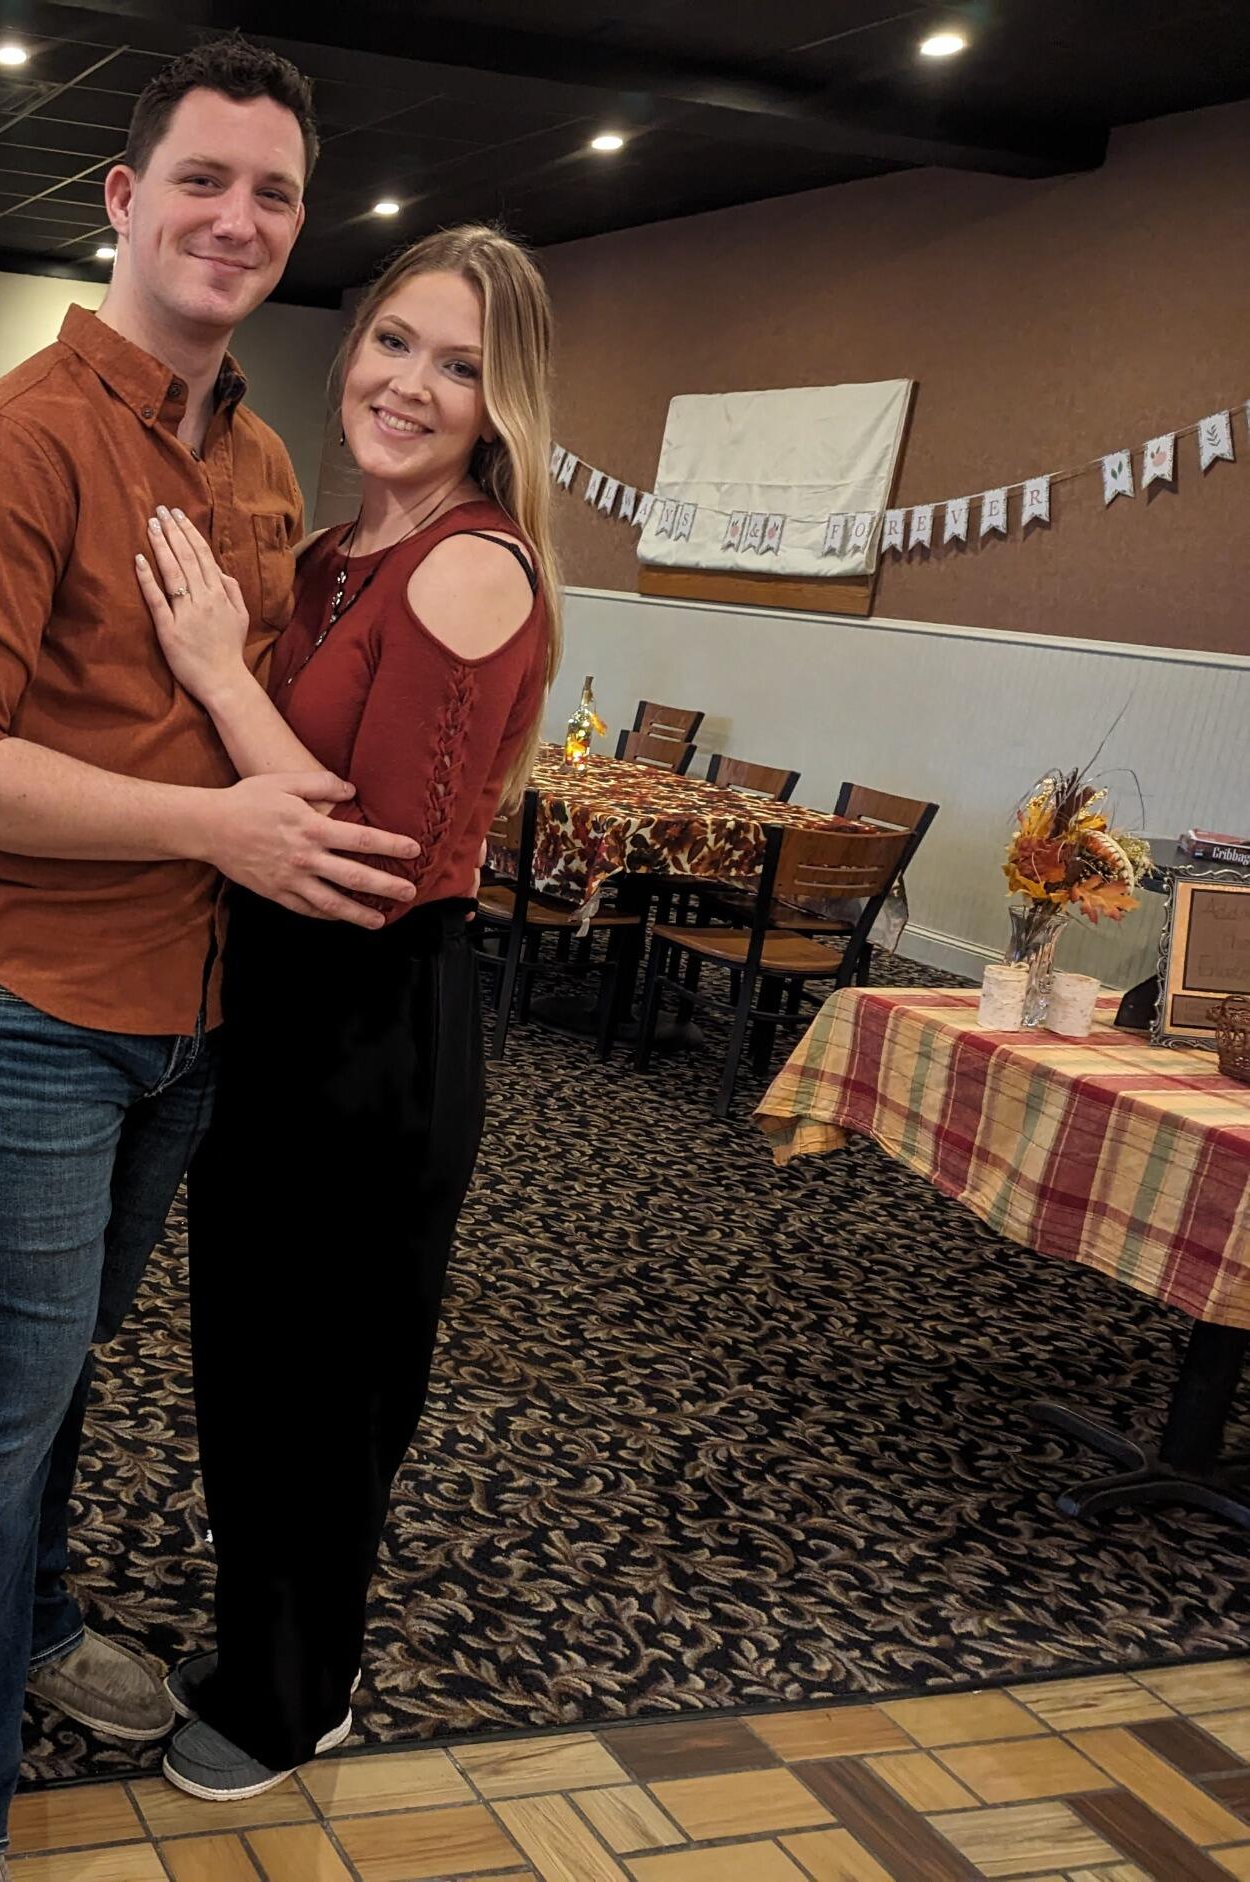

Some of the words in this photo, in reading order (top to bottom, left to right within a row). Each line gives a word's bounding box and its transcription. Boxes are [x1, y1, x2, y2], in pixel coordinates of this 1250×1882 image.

[589, 480, 689, 527] ALWAYS
[749, 525, 761, 539] &
[830, 489, 1043, 540] FOREVER
